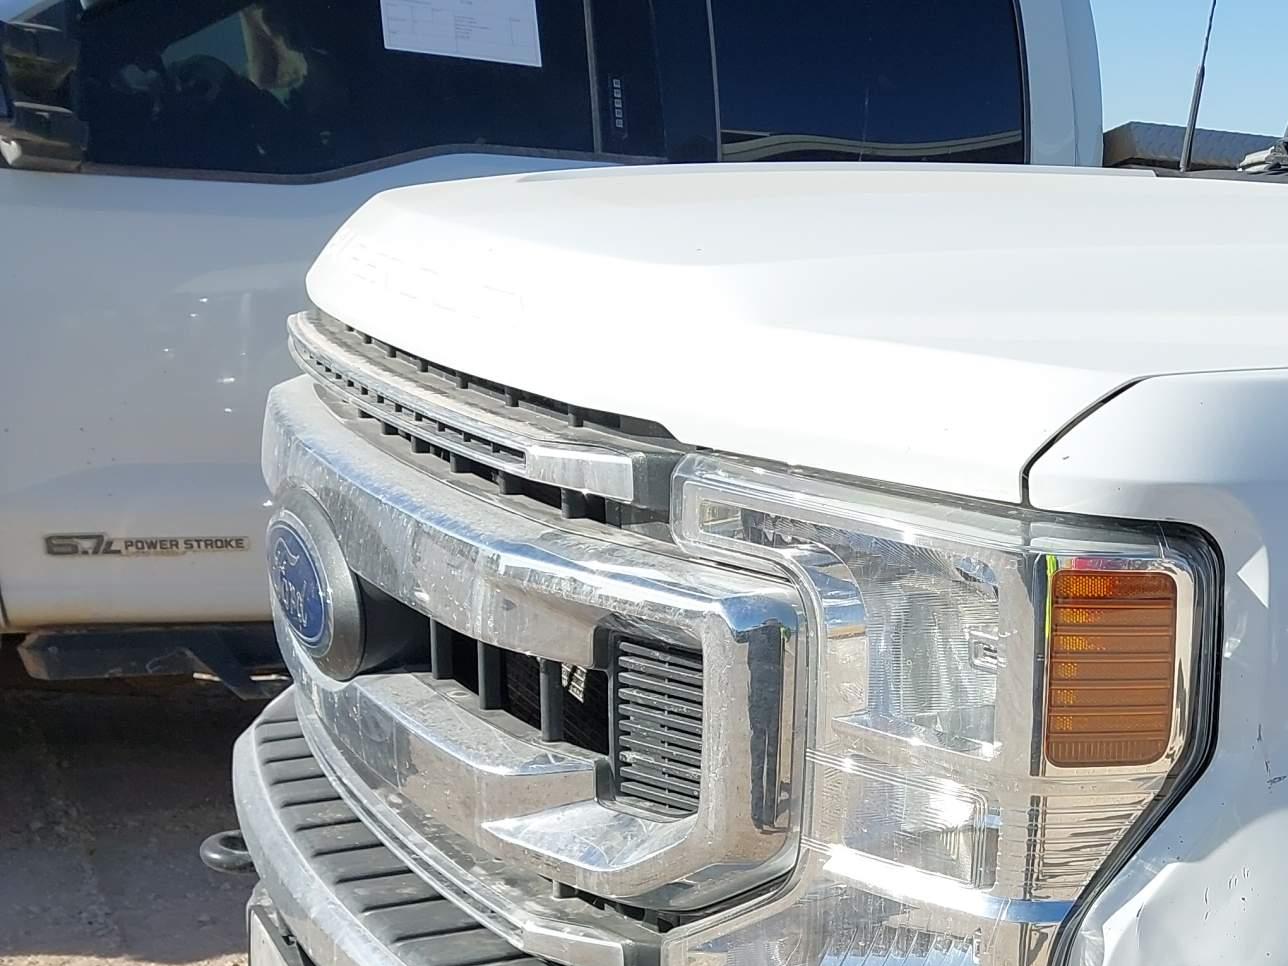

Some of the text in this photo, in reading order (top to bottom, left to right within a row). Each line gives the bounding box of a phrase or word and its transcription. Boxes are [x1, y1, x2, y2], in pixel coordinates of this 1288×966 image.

[45, 533, 246, 555] 6.7L POWER STROKE
[272, 536, 309, 629] Ford
